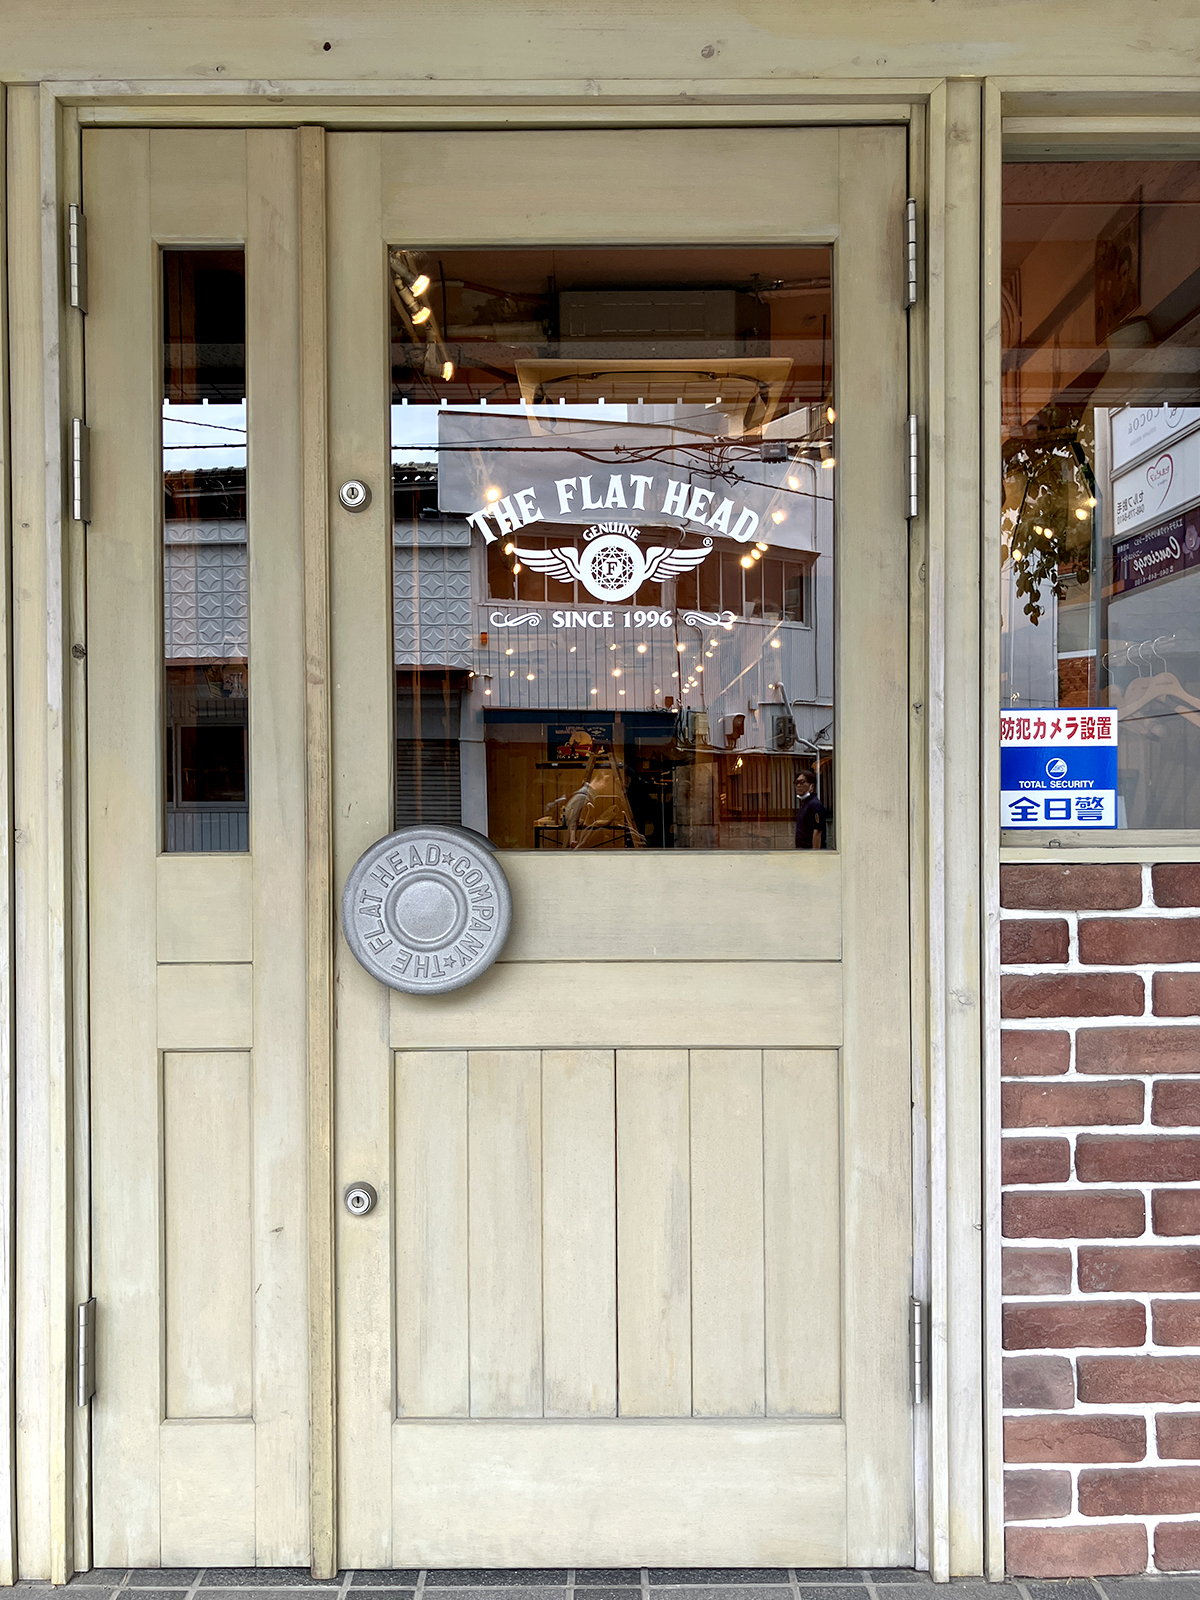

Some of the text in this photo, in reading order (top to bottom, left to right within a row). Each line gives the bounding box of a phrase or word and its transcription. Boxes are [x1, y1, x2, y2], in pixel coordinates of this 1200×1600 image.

[465, 474, 759, 545] THE FLAT HEAD
[582, 521, 641, 542] GENUINE
[606, 561, 618, 576] F
[552, 610, 673, 628] SINCE 1996
[1000, 717, 1112, 740] 防犯カメラ設置
[1019, 780, 1094, 789] TOTAL SECURITY
[1008, 796, 1105, 821] 全日警
[359, 843, 495, 978] THE FLAT HEAD COMPANY
